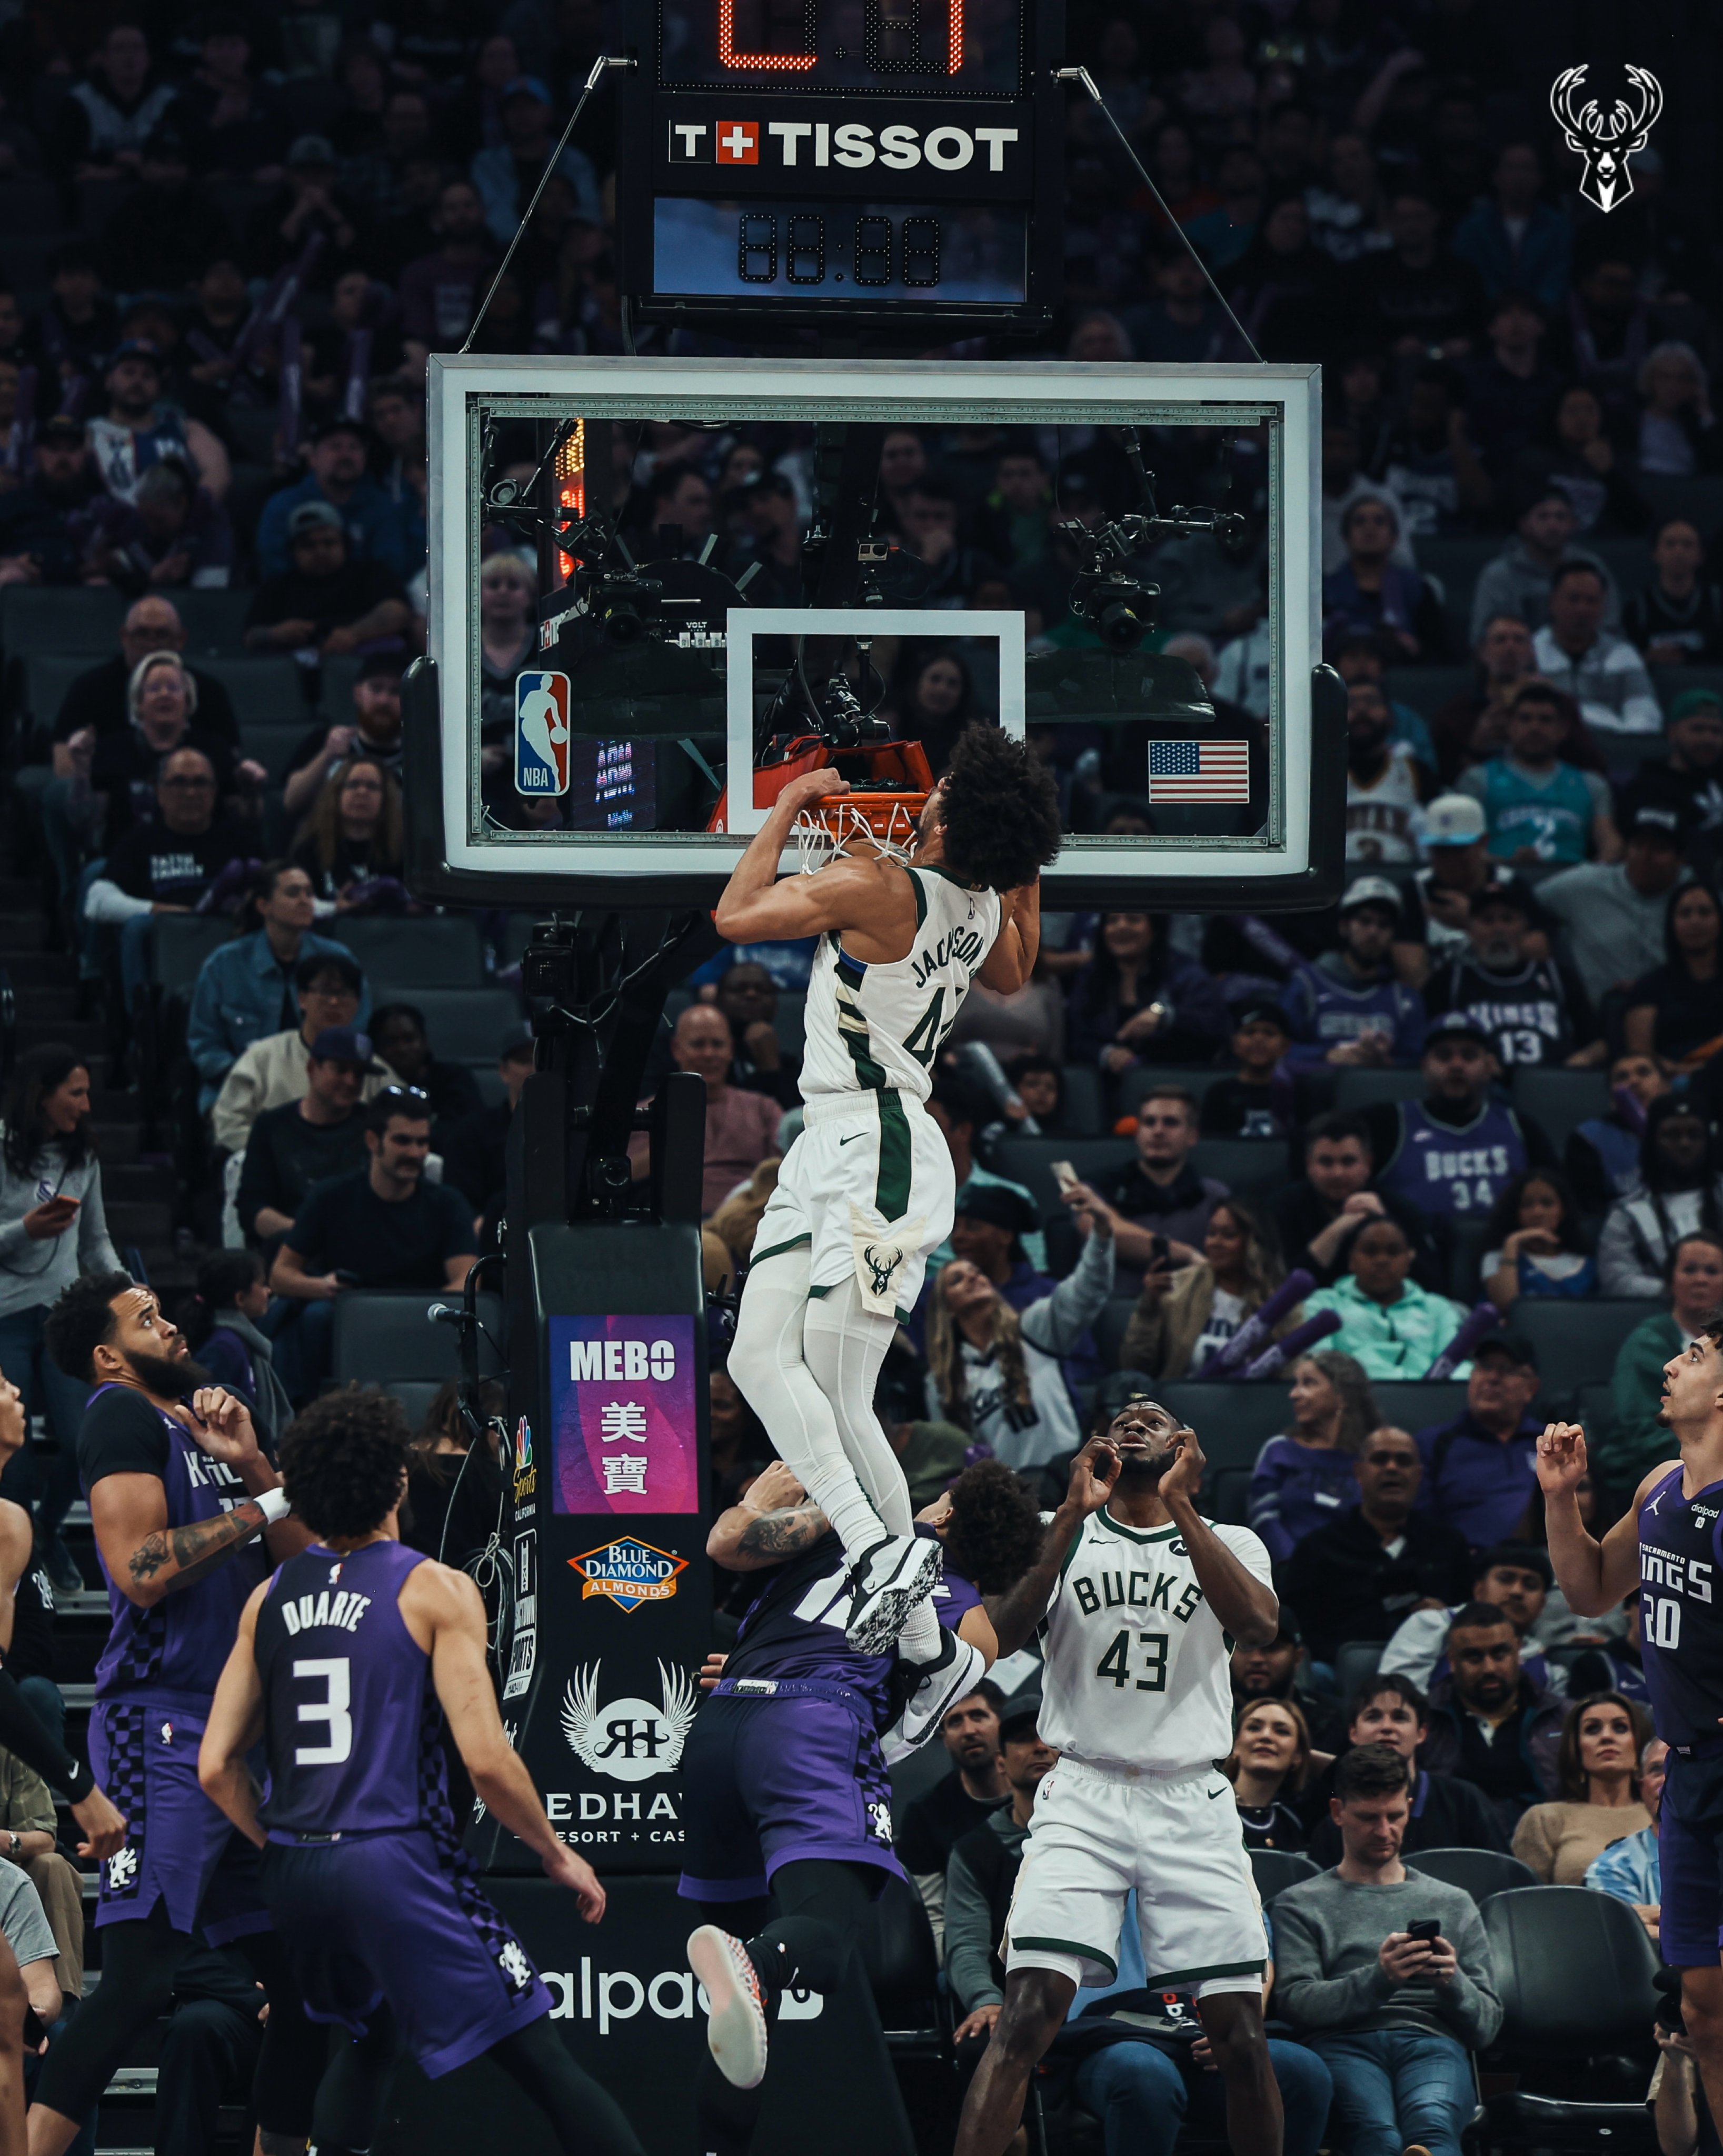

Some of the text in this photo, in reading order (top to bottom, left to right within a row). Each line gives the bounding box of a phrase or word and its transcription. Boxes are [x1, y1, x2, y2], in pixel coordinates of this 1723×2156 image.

[769, 122, 1018, 171] TISSOT
[524, 767, 549, 786] NBA
[1500, 1030, 1541, 1064] 13
[1426, 1145, 1508, 1181] BUCKS
[1451, 1180, 1493, 1209] 34
[570, 1340, 675, 1381] MEBO
[601, 1401, 648, 1495] 美寶
[513, 1464, 537, 1508] Sports
[515, 1503, 536, 1522] CALIFORNIA
[1691, 1503, 1719, 1518] dialpad
[585, 1559, 674, 1579] DIAMOND
[609, 1545, 651, 1564] BLUE
[1642, 1544, 1686, 1564] SACRAMENTO
[590, 1581, 670, 1598] ALMONDS
[1639, 1542, 1712, 1604] INGS
[282, 1591, 372, 1635] DUARTE
[1072, 1571, 1204, 1624] BUCKS
[510, 1634, 534, 1676] SPORTS
[1095, 1629, 1170, 1694] 43
[293, 1658, 352, 1764] 3
[546, 1793, 682, 1820] EDHA
[555, 1831, 621, 1842] ESORT
[539, 1957, 711, 2034] alpa
